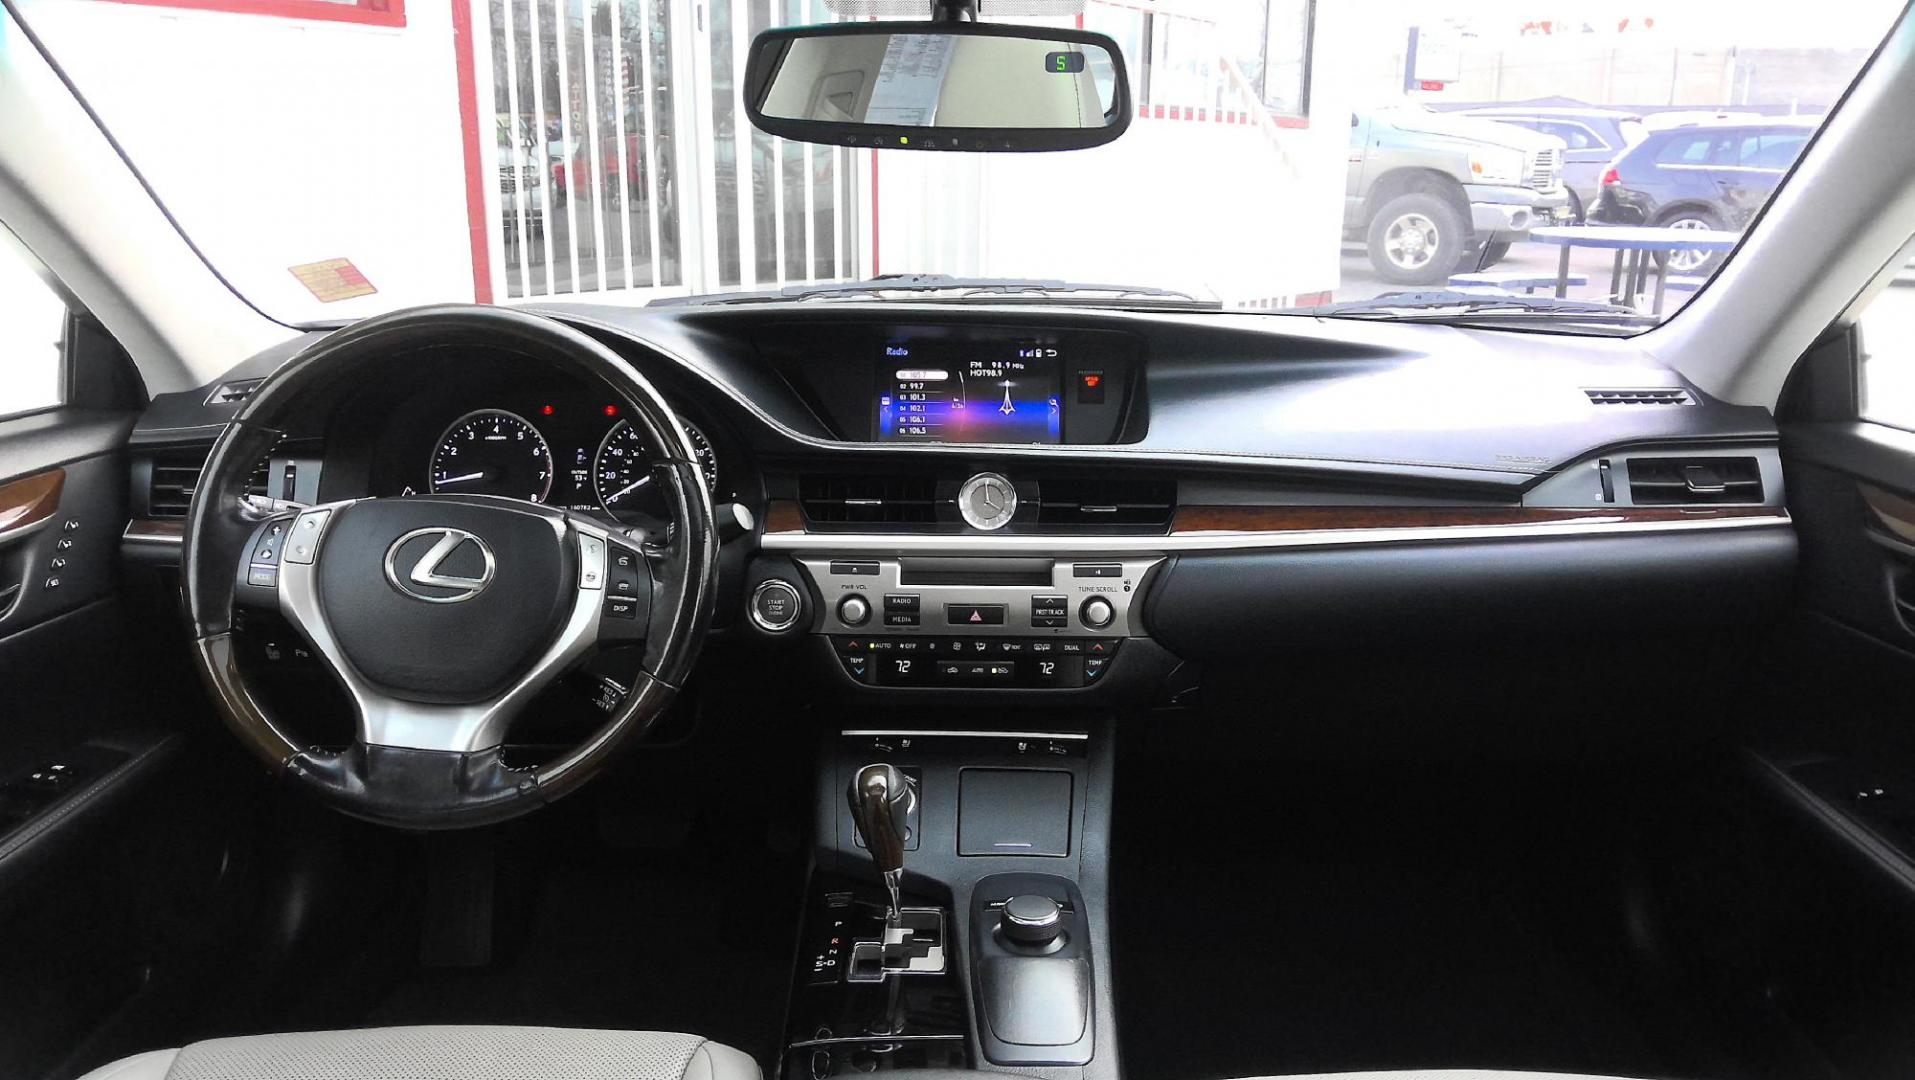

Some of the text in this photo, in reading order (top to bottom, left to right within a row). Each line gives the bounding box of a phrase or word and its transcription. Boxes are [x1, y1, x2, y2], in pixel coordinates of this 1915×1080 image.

[886, 347, 908, 356] Radio
[992, 361, 1010, 369] 98.9
[970, 369, 1002, 377] HOT98.9
[493, 424, 499, 434] 4
[468, 431, 475, 440] 3
[517, 431, 524, 440] 5
[450, 447, 457, 456] 2
[533, 447, 540, 456] 6
[612, 448, 623, 457] 40
[539, 471, 546, 480] 7
[605, 471, 616, 480] 20
[530, 494, 537, 503] 8
[895, 660, 911, 673] 72
[1039, 662, 1055, 675] 72
